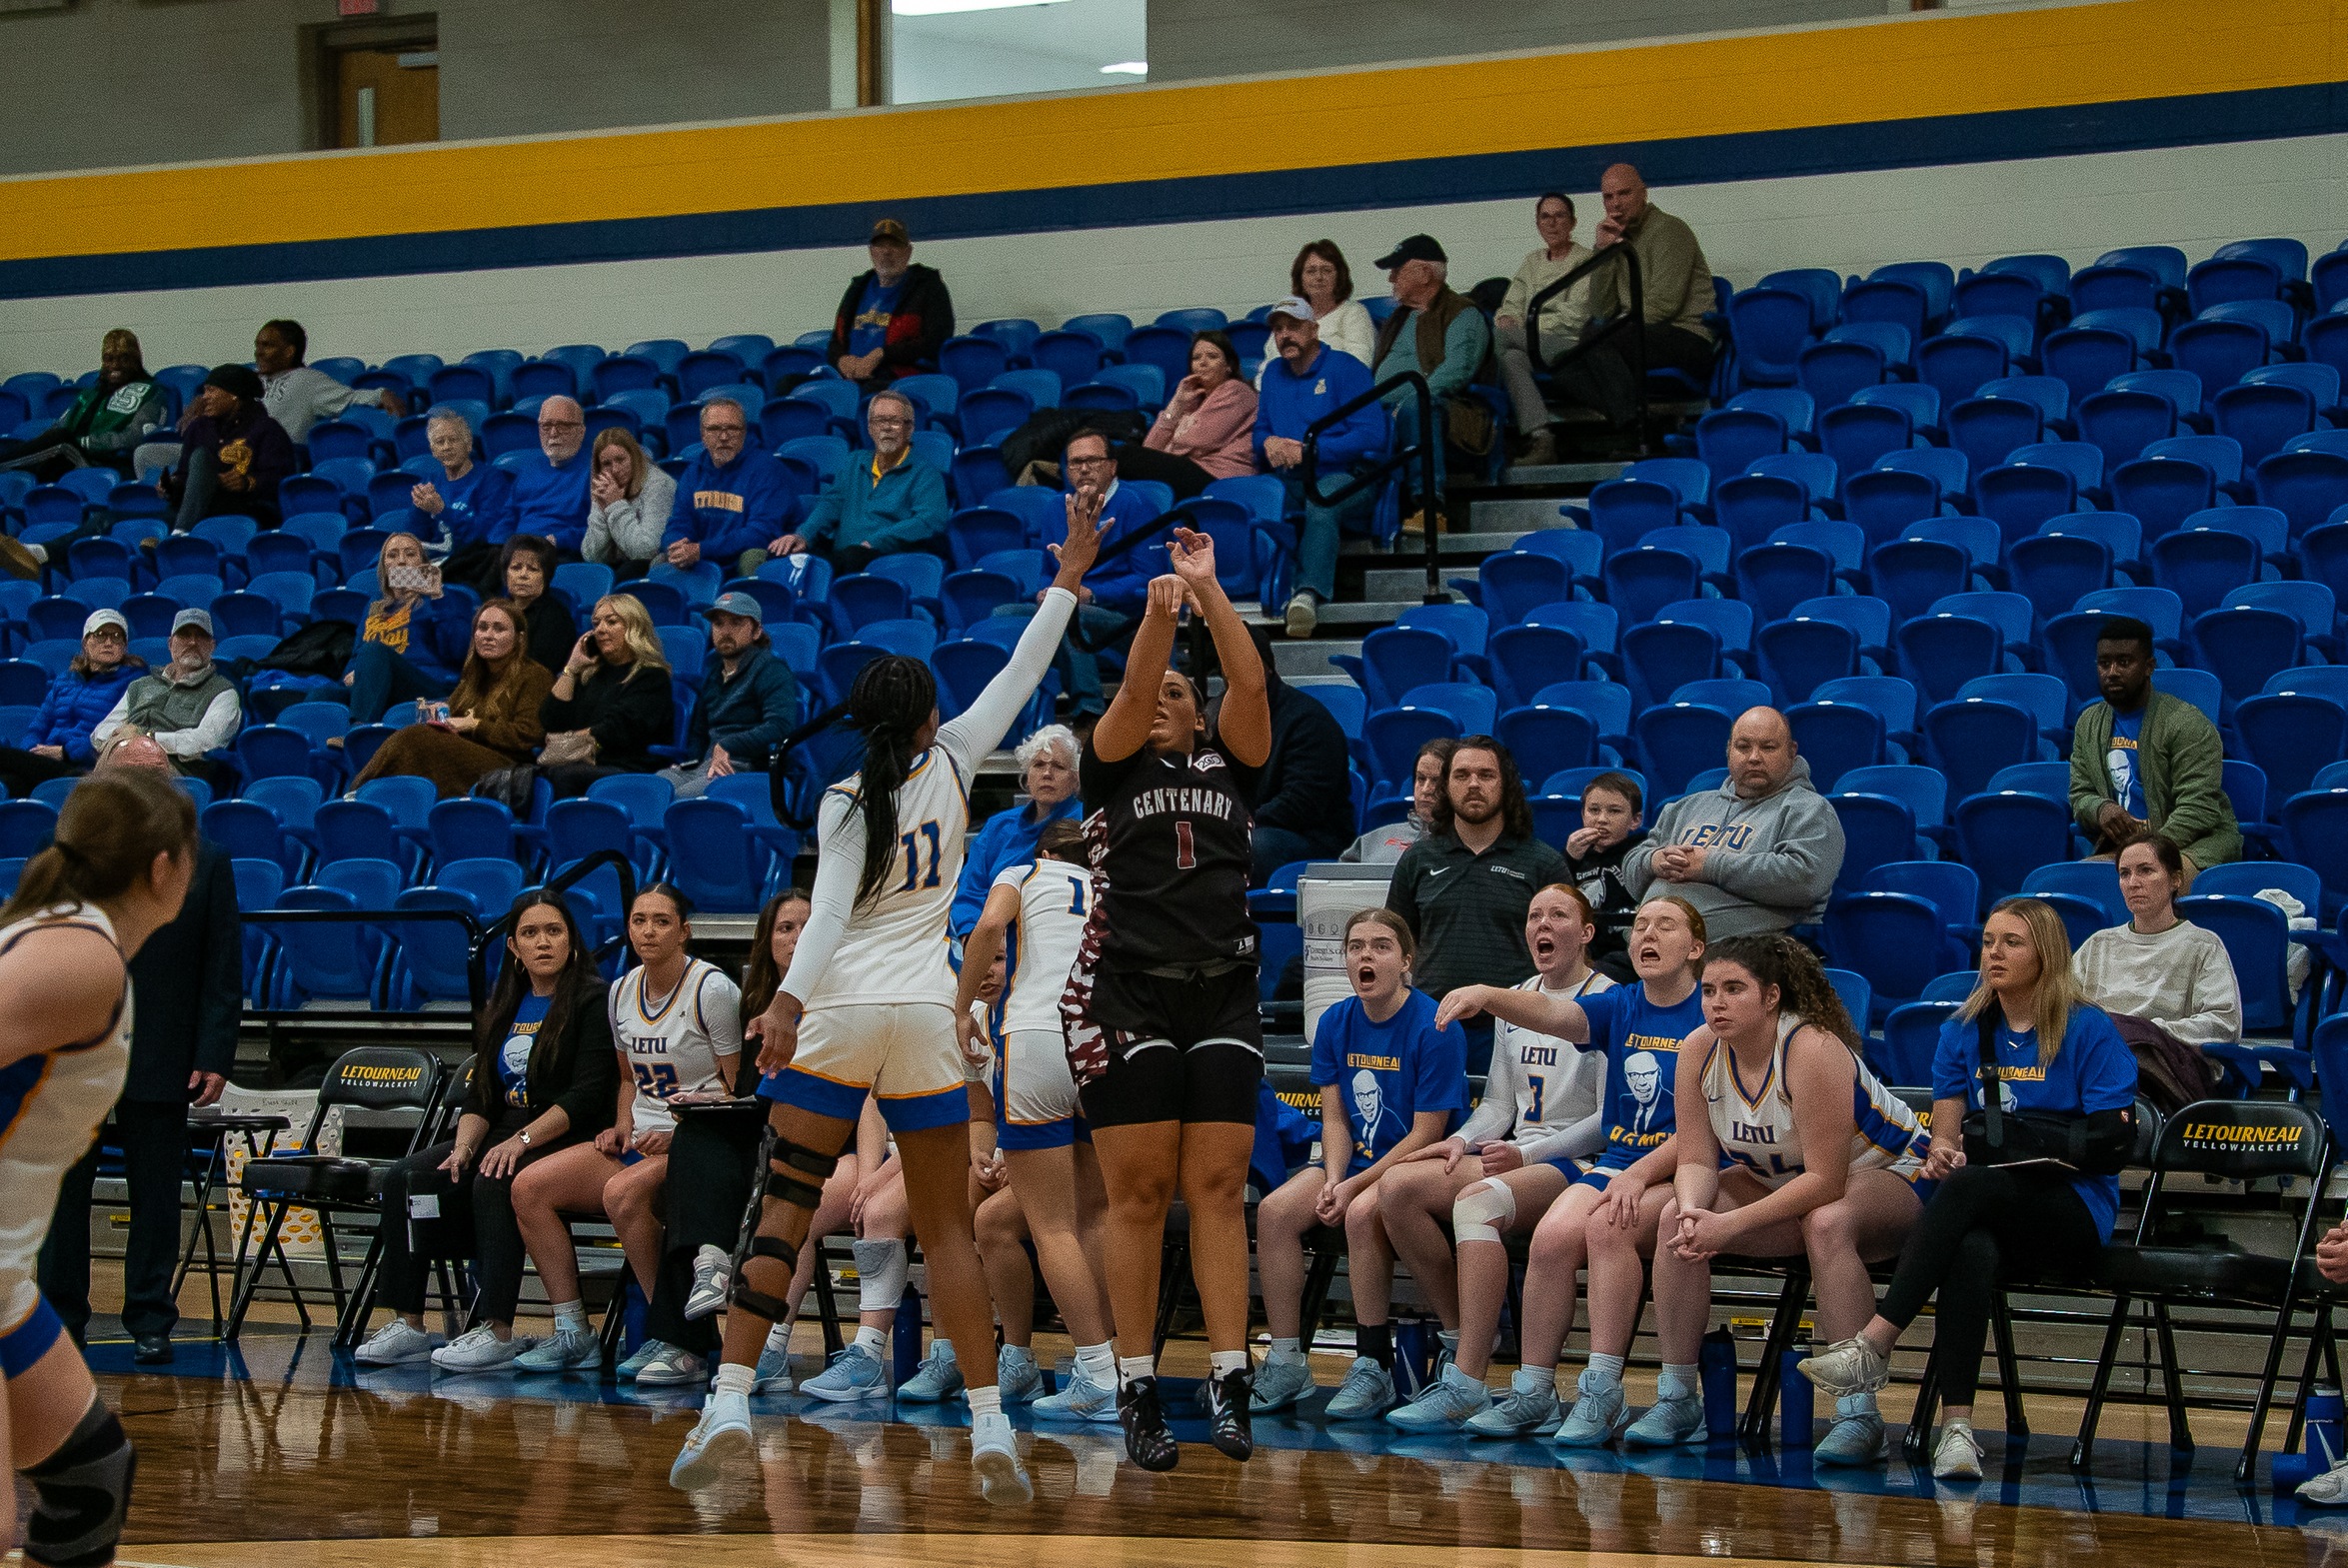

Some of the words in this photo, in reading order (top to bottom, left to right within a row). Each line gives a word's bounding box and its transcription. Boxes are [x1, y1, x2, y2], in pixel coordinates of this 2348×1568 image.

[1133, 787, 1232, 820] CENTENARY
[900, 818, 942, 892] 11
[1175, 820, 1196, 869] 1
[632, 1036, 668, 1054] LETU
[1520, 1045, 1557, 1067] LETU
[340, 1078, 418, 1088] YELLOWJACKETS
[341, 1064, 422, 1080] LETOURNEAU
[632, 1061, 680, 1099] 22
[1523, 1073, 1545, 1123] 3
[1732, 1120, 1776, 1144] LETU
[2182, 1123, 2303, 1141] LETOURNEAU
[2183, 1139, 2300, 1152] YELLOWJACKETS
